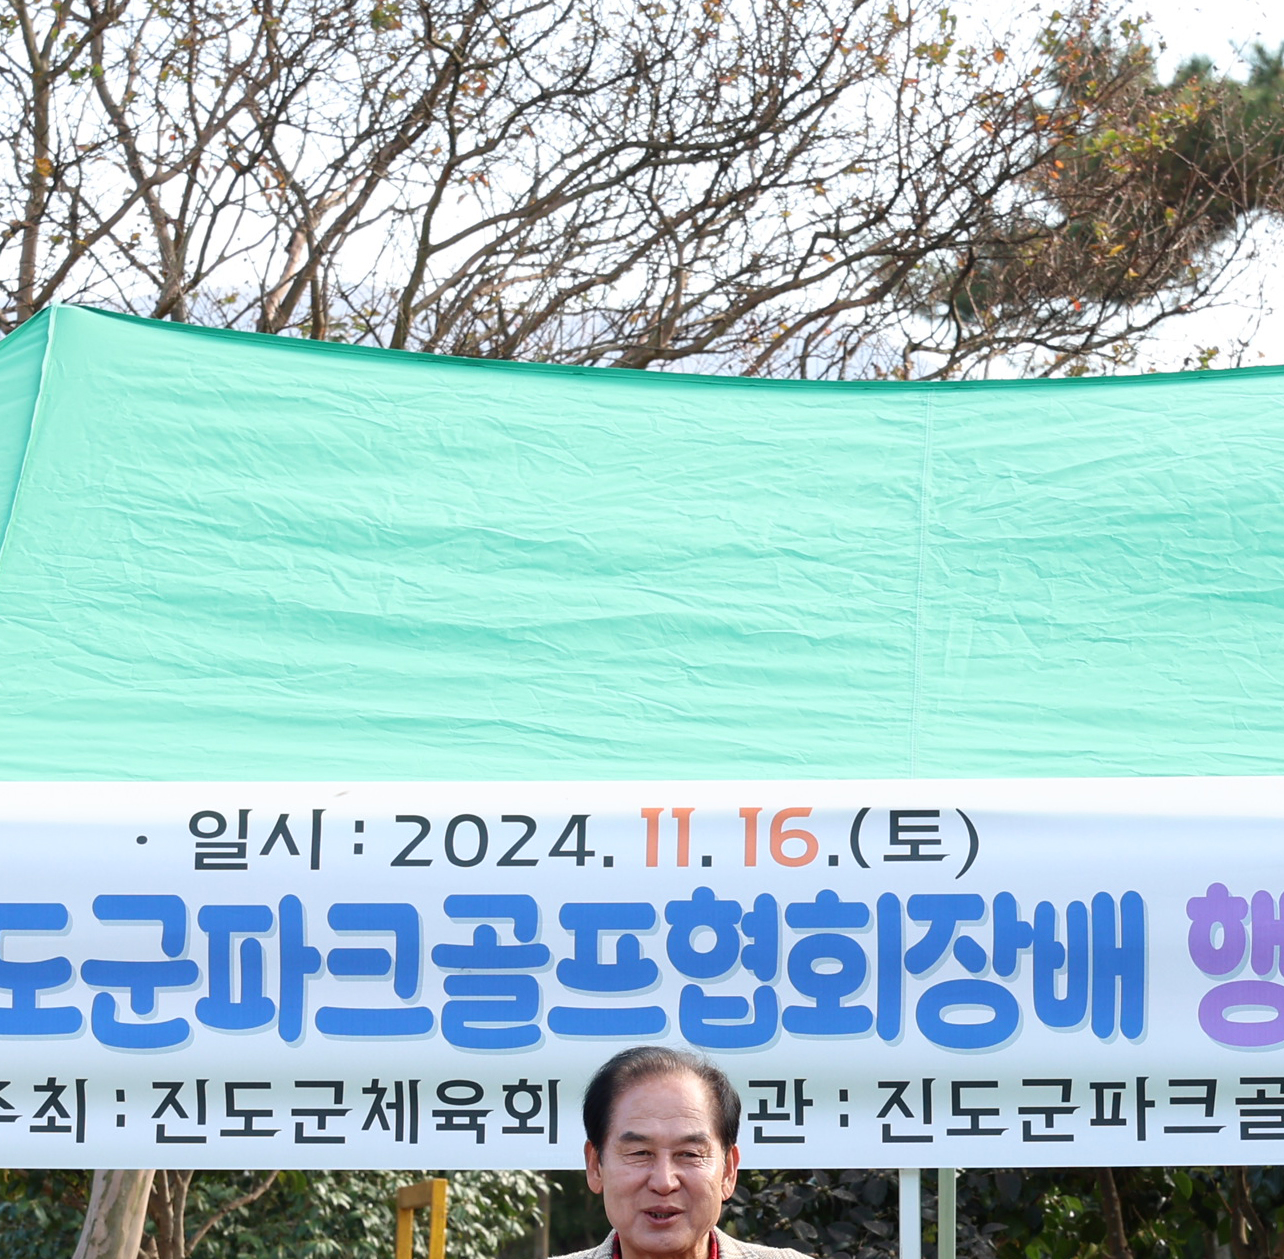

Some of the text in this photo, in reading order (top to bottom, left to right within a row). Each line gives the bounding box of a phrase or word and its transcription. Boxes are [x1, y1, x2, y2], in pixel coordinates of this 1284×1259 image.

[187, 808, 327, 872] 일시
[389, 813, 615, 869] 2024.
[640, 806, 713, 868] 11.
[150, 1077, 562, 1146] 진도군체육회
[747, 1078, 815, 1145] 관
